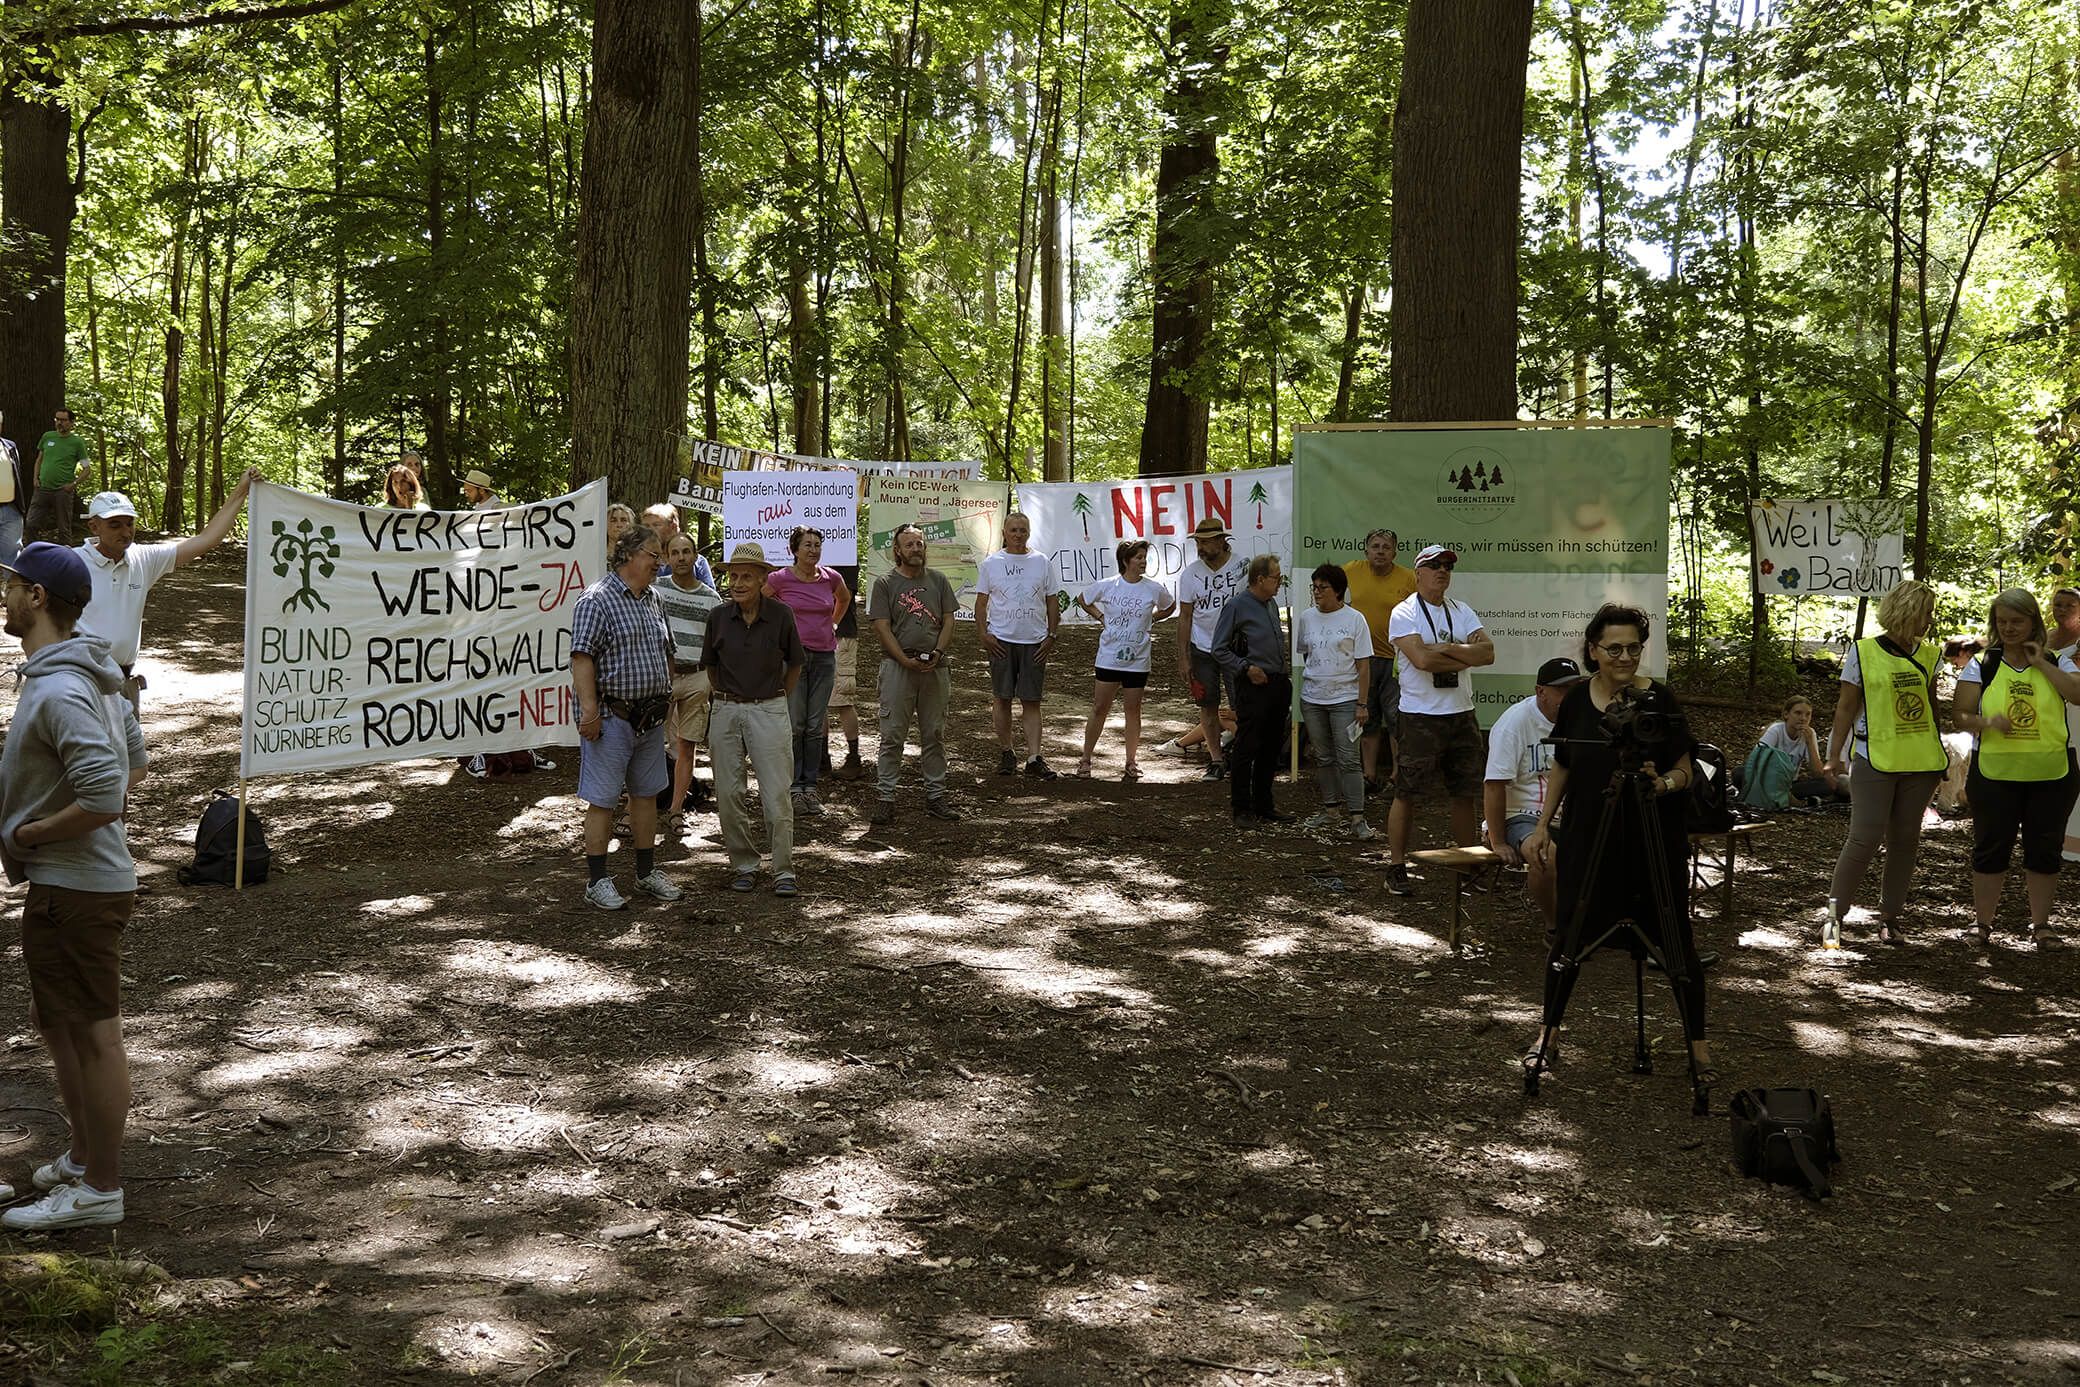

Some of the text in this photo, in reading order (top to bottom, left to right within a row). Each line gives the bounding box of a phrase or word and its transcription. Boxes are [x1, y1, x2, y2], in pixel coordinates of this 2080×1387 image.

[692, 441, 741, 471] KEIN
[724, 481, 854, 500] Flughafen-Nordanbindung
[880, 480, 959, 492] Kein ICE-Werk
[918, 496, 940, 505] und
[1111, 479, 1232, 538] NEIN
[758, 499, 847, 525] raus aus dem
[358, 500, 594, 552] VERKEHRS-
[1762, 505, 1841, 548] Weil
[1304, 536, 1366, 551] Der Wald
[1471, 540, 1493, 552] wir
[1497, 539, 1553, 552] müssen
[1558, 539, 1581, 552] ihn
[1585, 539, 1658, 553] schützen!
[1004, 564, 1025, 577] Wir
[1806, 555, 1901, 592] Baum
[1204, 571, 1236, 590] ICE
[1006, 608, 1036, 620] NICHT
[1109, 616, 1129, 628] VOM
[1120, 608, 1143, 618] WEG
[1528, 609, 1538, 619] ist
[1110, 629, 1144, 644] WALD
[1491, 628, 1505, 636] ein
[1507, 628, 1538, 637] kleines
[1541, 628, 1560, 637] Dorf
[260, 626, 351, 664] BUND
[367, 627, 573, 685] REICHSWALD
[258, 667, 351, 695] NATUR-
[254, 697, 349, 728] SCHUTZ
[253, 724, 352, 754] NÜRNBERG
